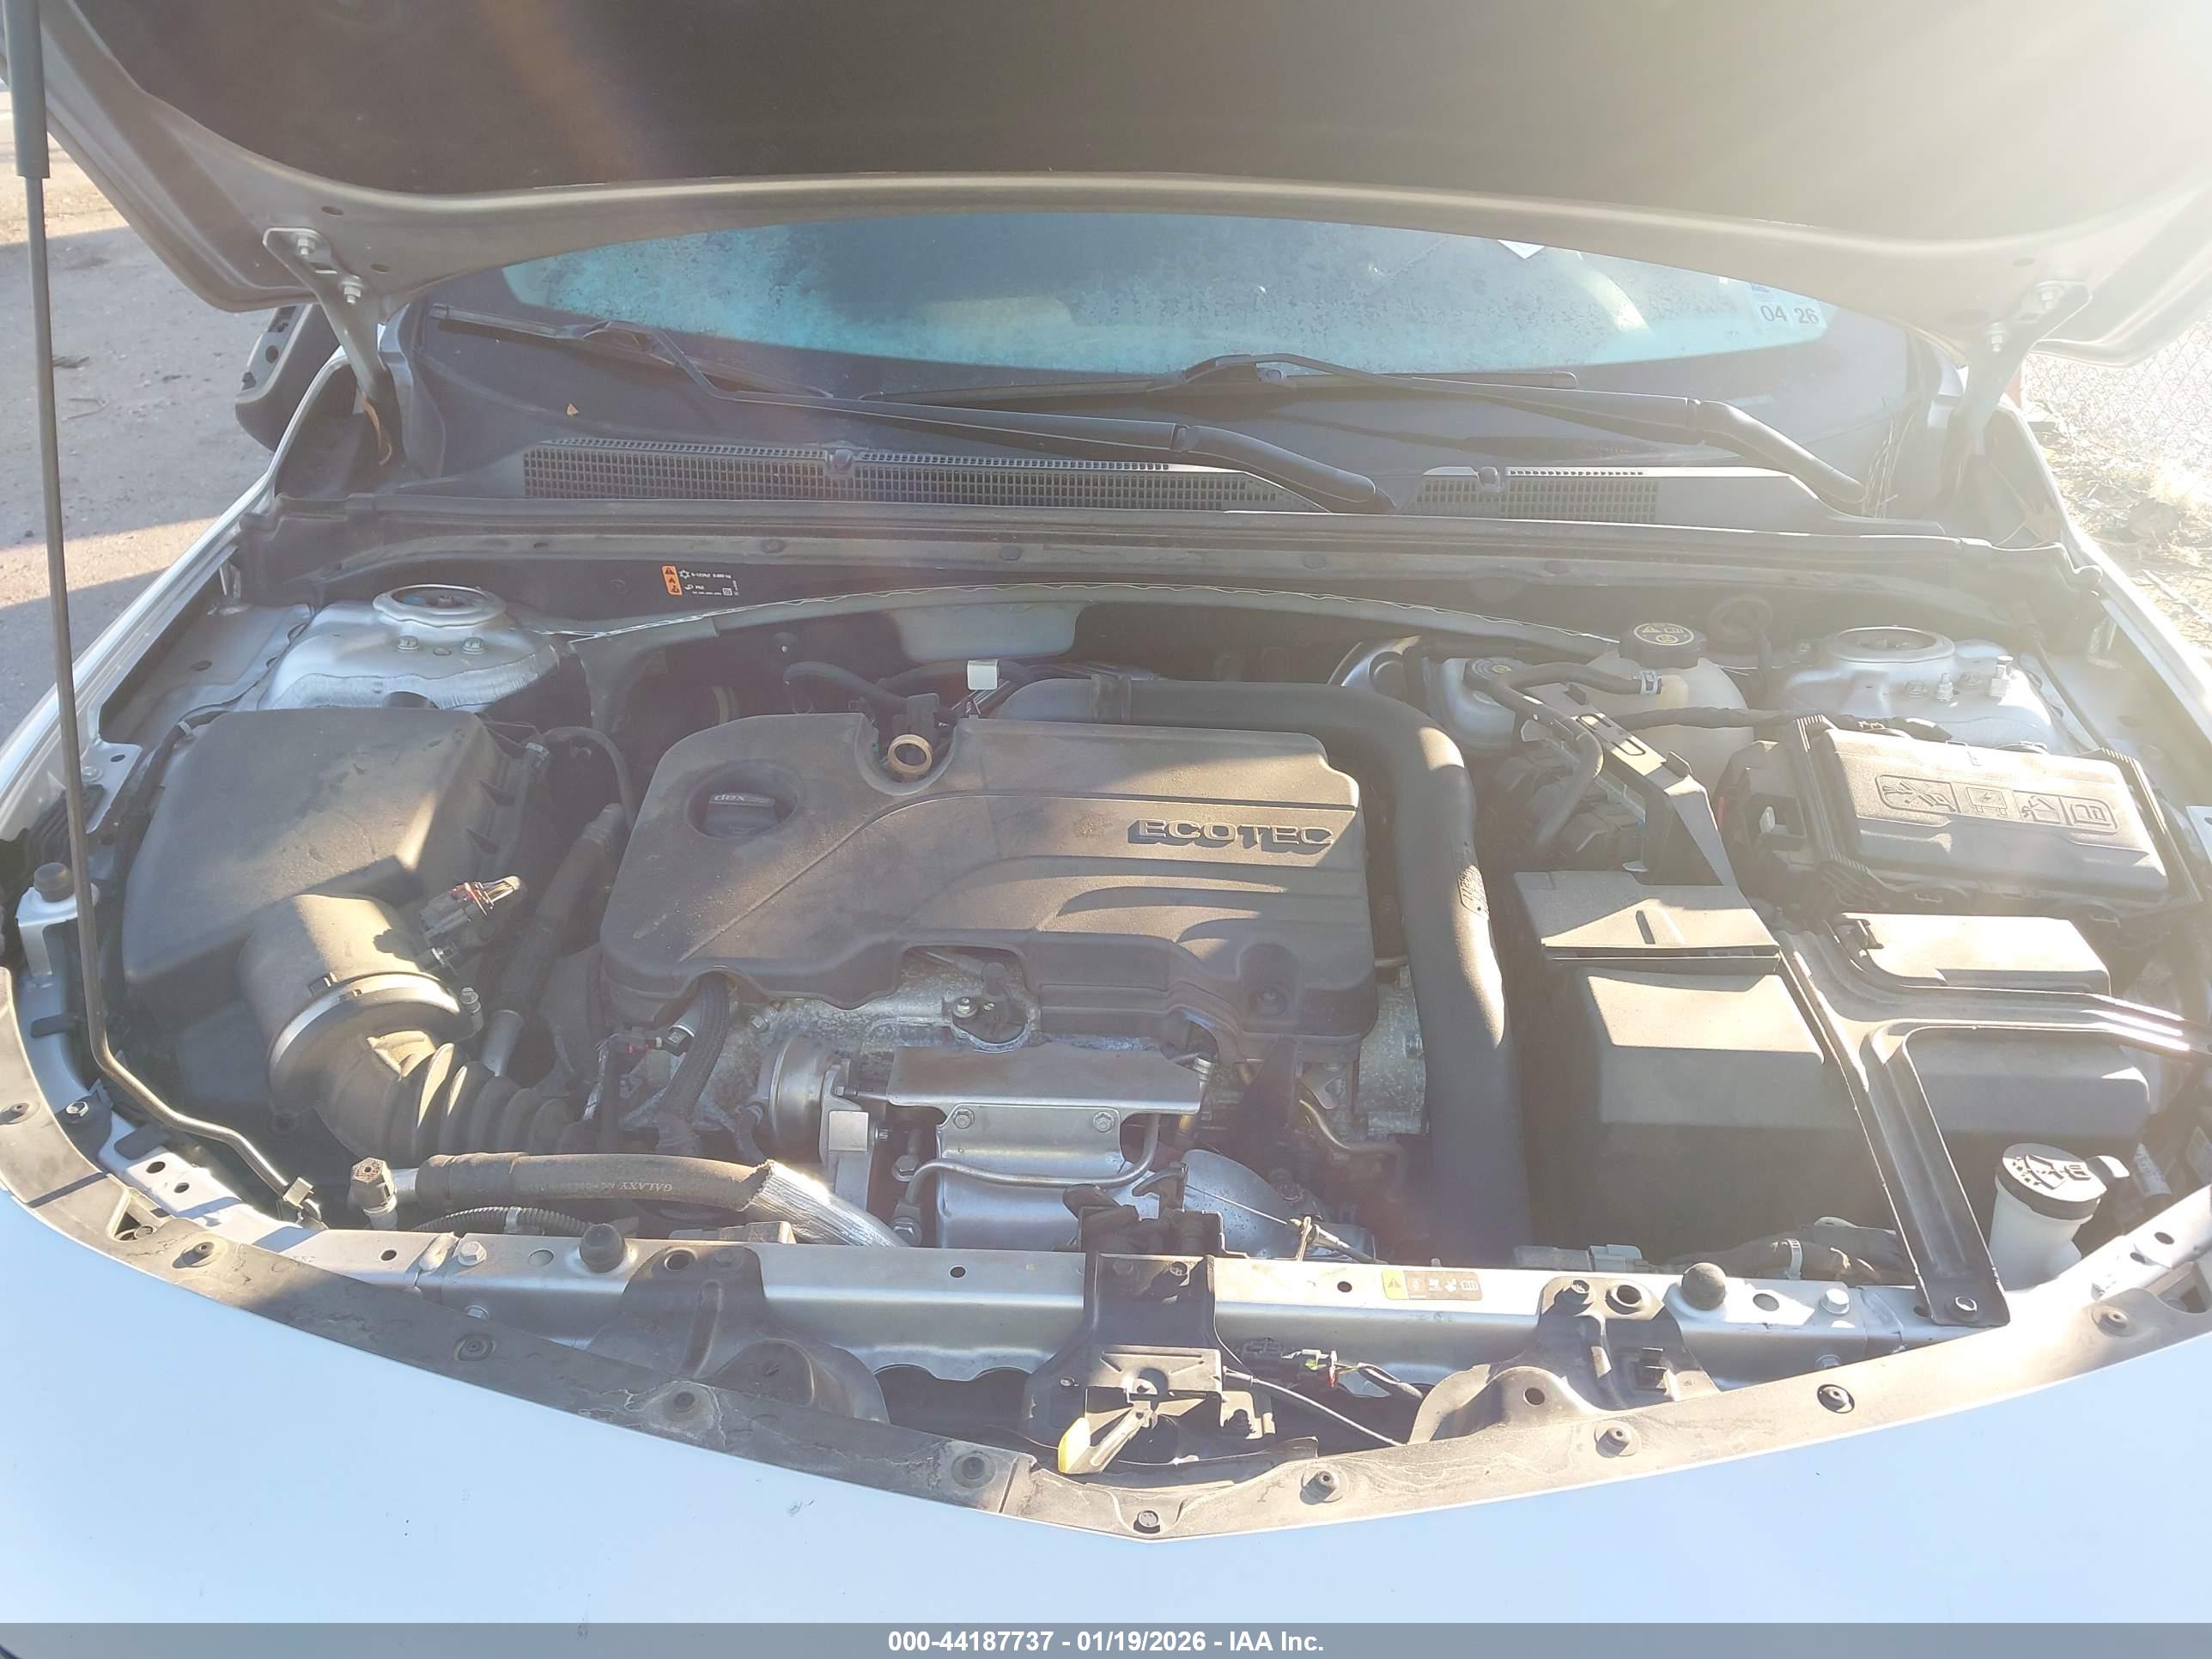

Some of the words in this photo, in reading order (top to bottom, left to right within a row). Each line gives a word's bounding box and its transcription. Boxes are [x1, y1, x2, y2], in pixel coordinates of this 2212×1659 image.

[1761, 305, 1788, 322] 04
[1794, 307, 1820, 325] 26
[1135, 818, 1334, 848] ECOTEC
[620, 1182, 673, 1192] GALAXY
